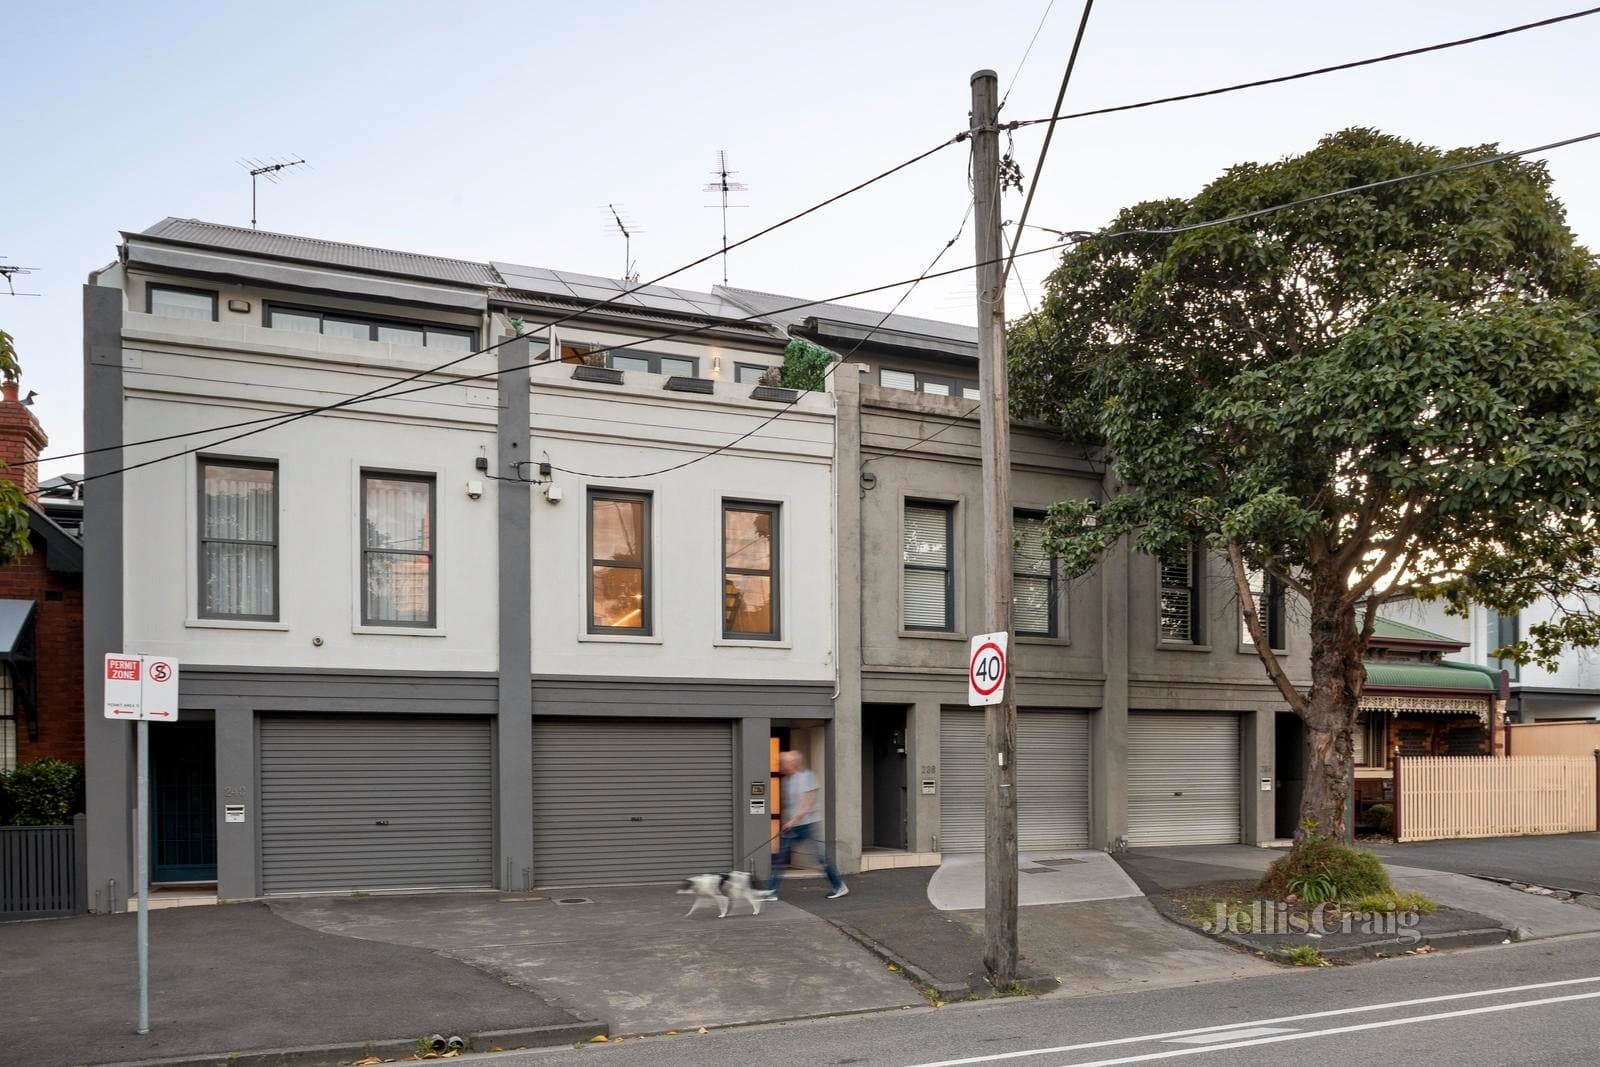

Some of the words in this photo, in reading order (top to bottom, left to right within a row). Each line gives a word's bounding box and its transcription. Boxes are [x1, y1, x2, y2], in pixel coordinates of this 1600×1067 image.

[109, 660, 137, 670] PERMIT
[976, 656, 1000, 682] 40
[112, 670, 136, 679] ZONE
[155, 665, 167, 679] S
